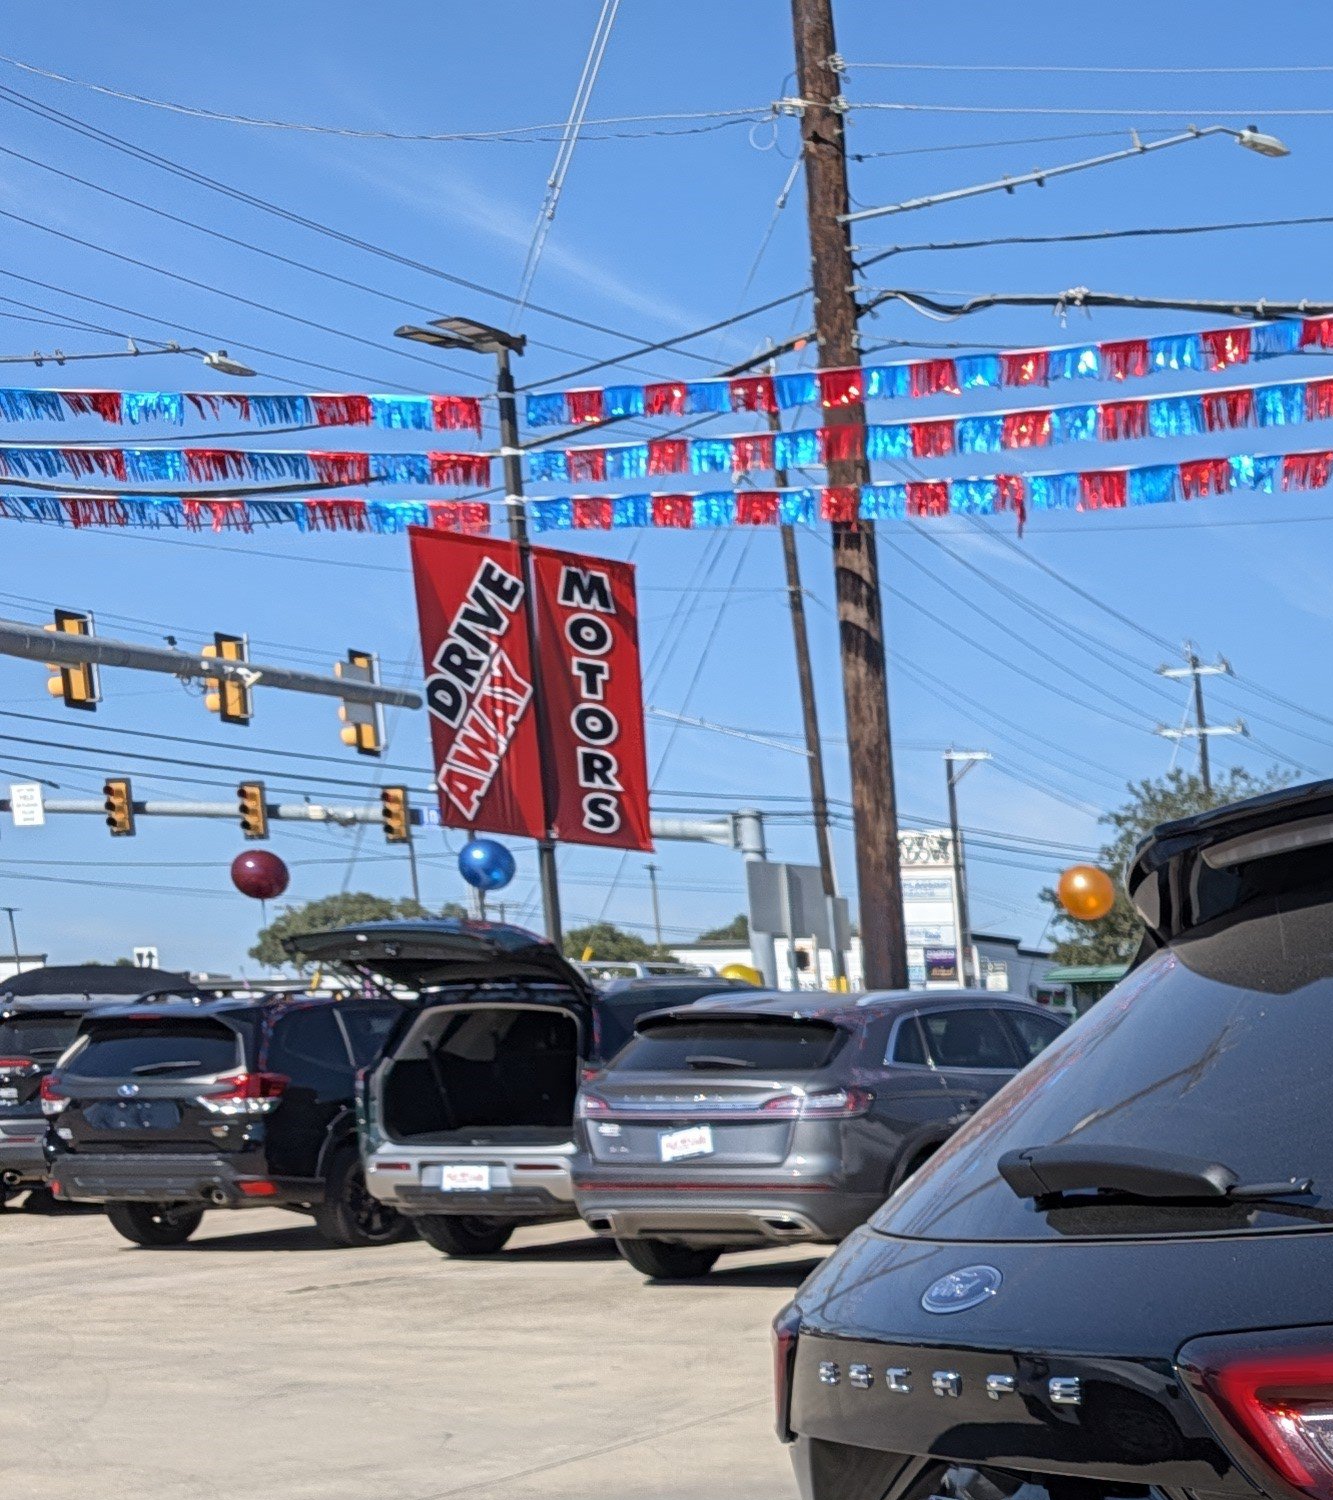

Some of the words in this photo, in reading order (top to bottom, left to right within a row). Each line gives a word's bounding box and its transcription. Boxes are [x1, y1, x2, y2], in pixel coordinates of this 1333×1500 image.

[425, 556, 525, 729] DRIVE
[557, 565, 624, 834] MOTORS
[437, 648, 534, 822] AWAY
[818, 1360, 1082, 1405] ESCAPE
